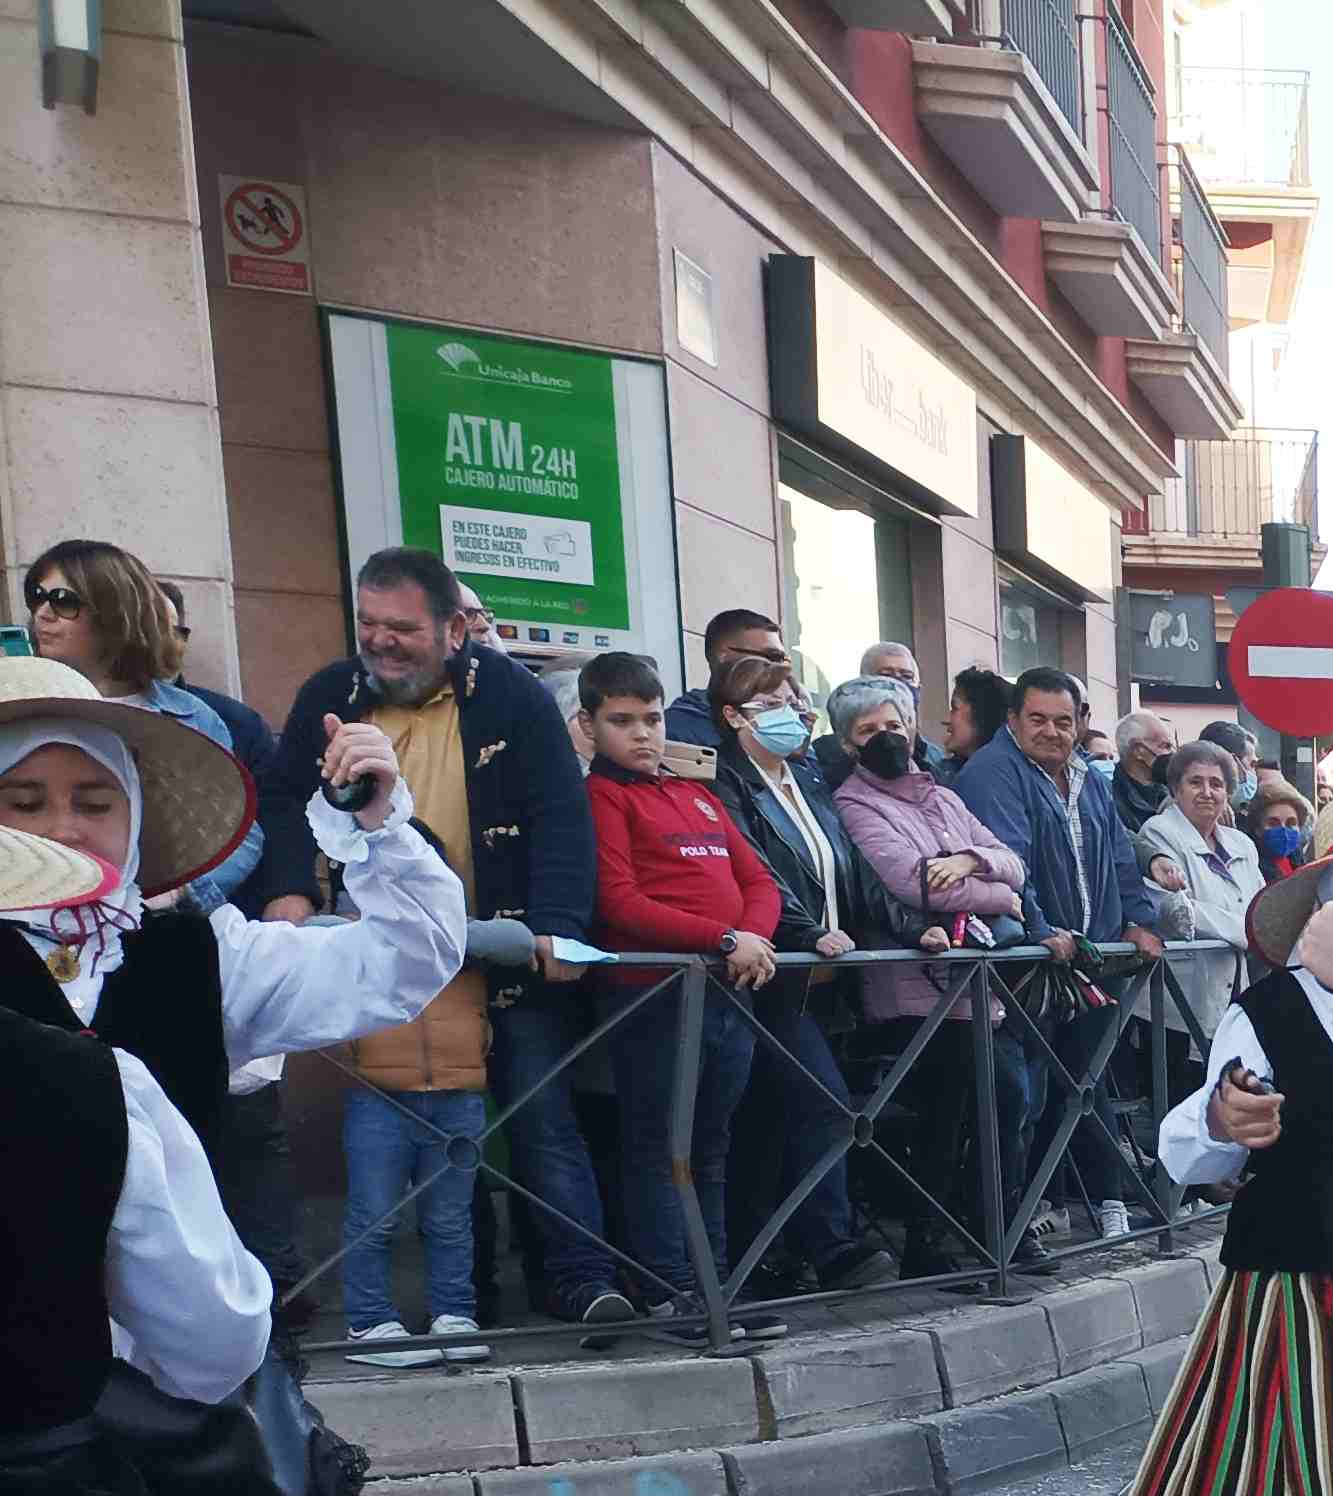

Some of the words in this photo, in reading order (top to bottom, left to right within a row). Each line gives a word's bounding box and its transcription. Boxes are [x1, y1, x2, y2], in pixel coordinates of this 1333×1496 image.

[478, 363, 530, 384] Unicaja
[531, 371, 573, 389] Banco
[445, 413, 525, 472] ATM
[530, 444, 577, 480] 24H
[444, 466, 495, 489] CAJERO
[498, 474, 579, 500] AUTOMÁTICO
[452, 520, 465, 534] EN
[467, 521, 492, 537] ESTE
[493, 525, 528, 540] CAJERO
[453, 535, 490, 551] PUEDES
[492, 539, 523, 554] HACER
[454, 549, 501, 566] INGRESOS
[502, 555, 515, 568] EN
[516, 556, 560, 573] EFECTIVO
[680, 846, 708, 857] POLO
